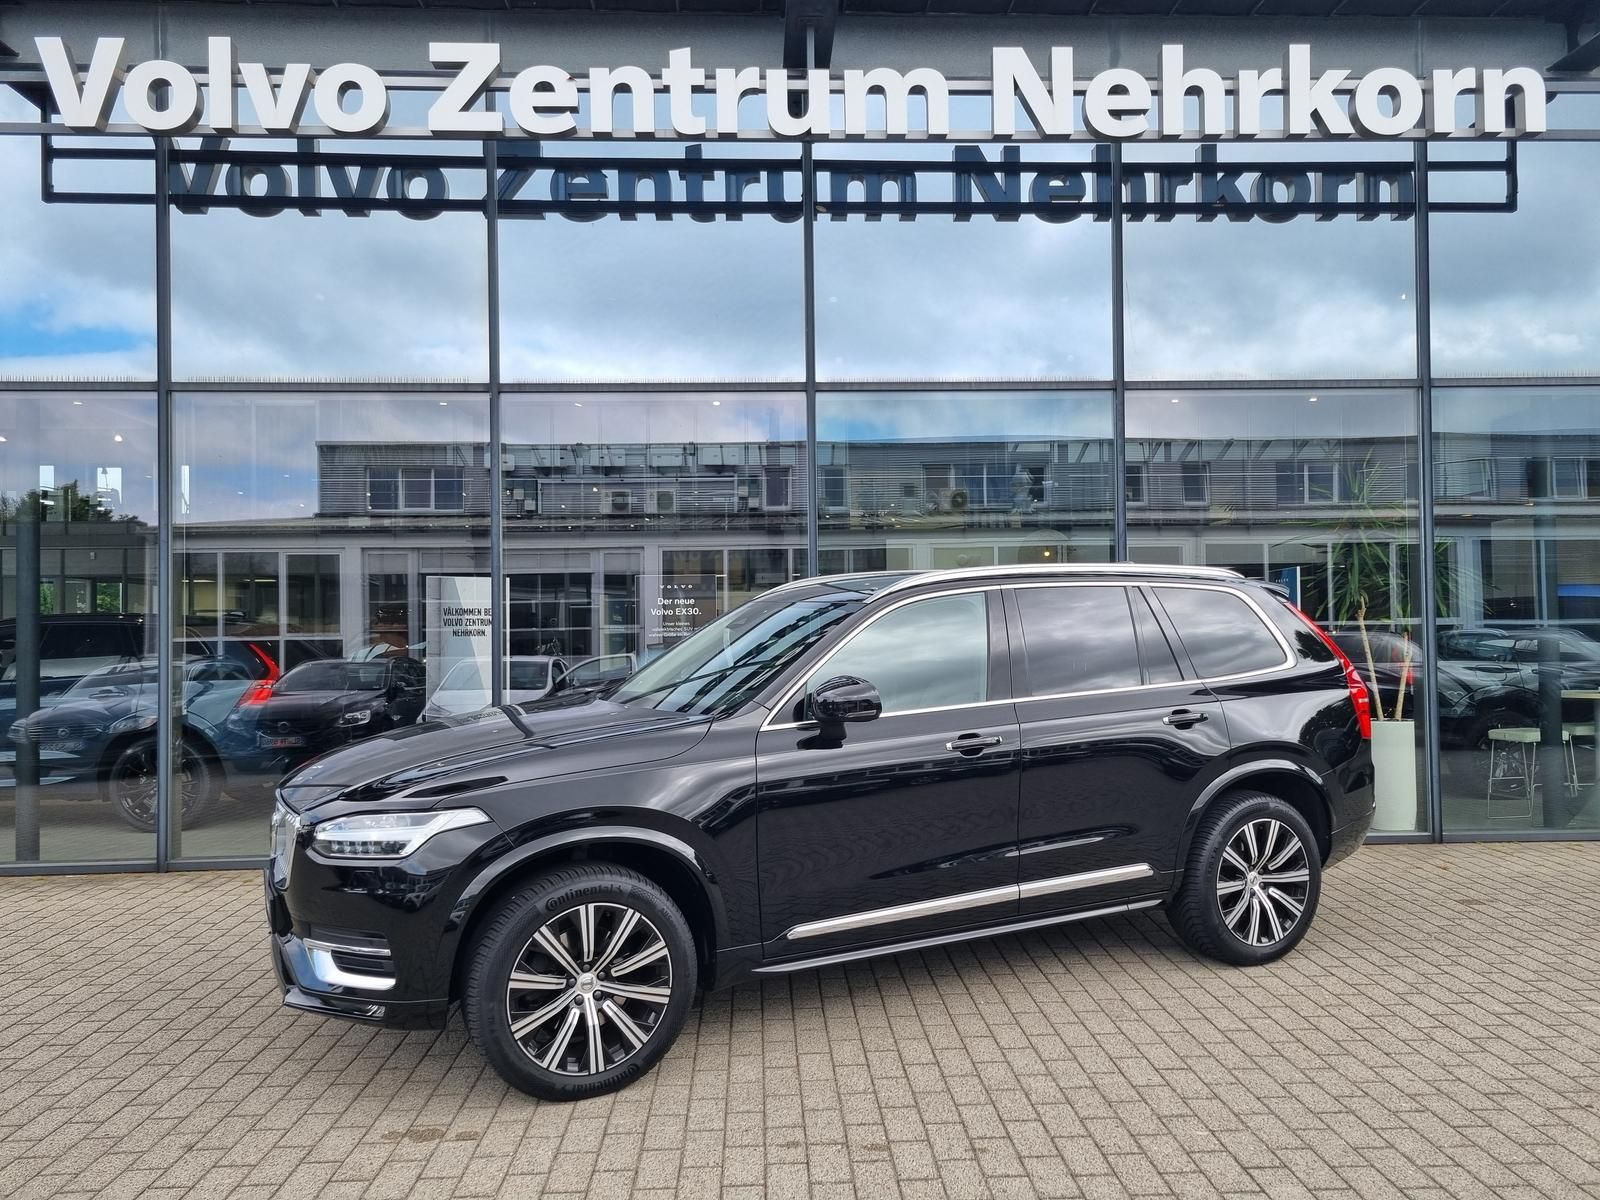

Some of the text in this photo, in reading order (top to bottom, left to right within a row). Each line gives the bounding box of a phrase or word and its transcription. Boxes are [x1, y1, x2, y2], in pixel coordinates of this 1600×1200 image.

[34, 36, 1548, 139] Volvo Zentrum Nehrkorn
[657, 597, 673, 605] Der
[650, 607, 702, 616] Volvo EX30.
[443, 618, 463, 626] VOLVO
[452, 629, 487, 637] NEHRKORN.
[545, 884, 614, 912] Continental
